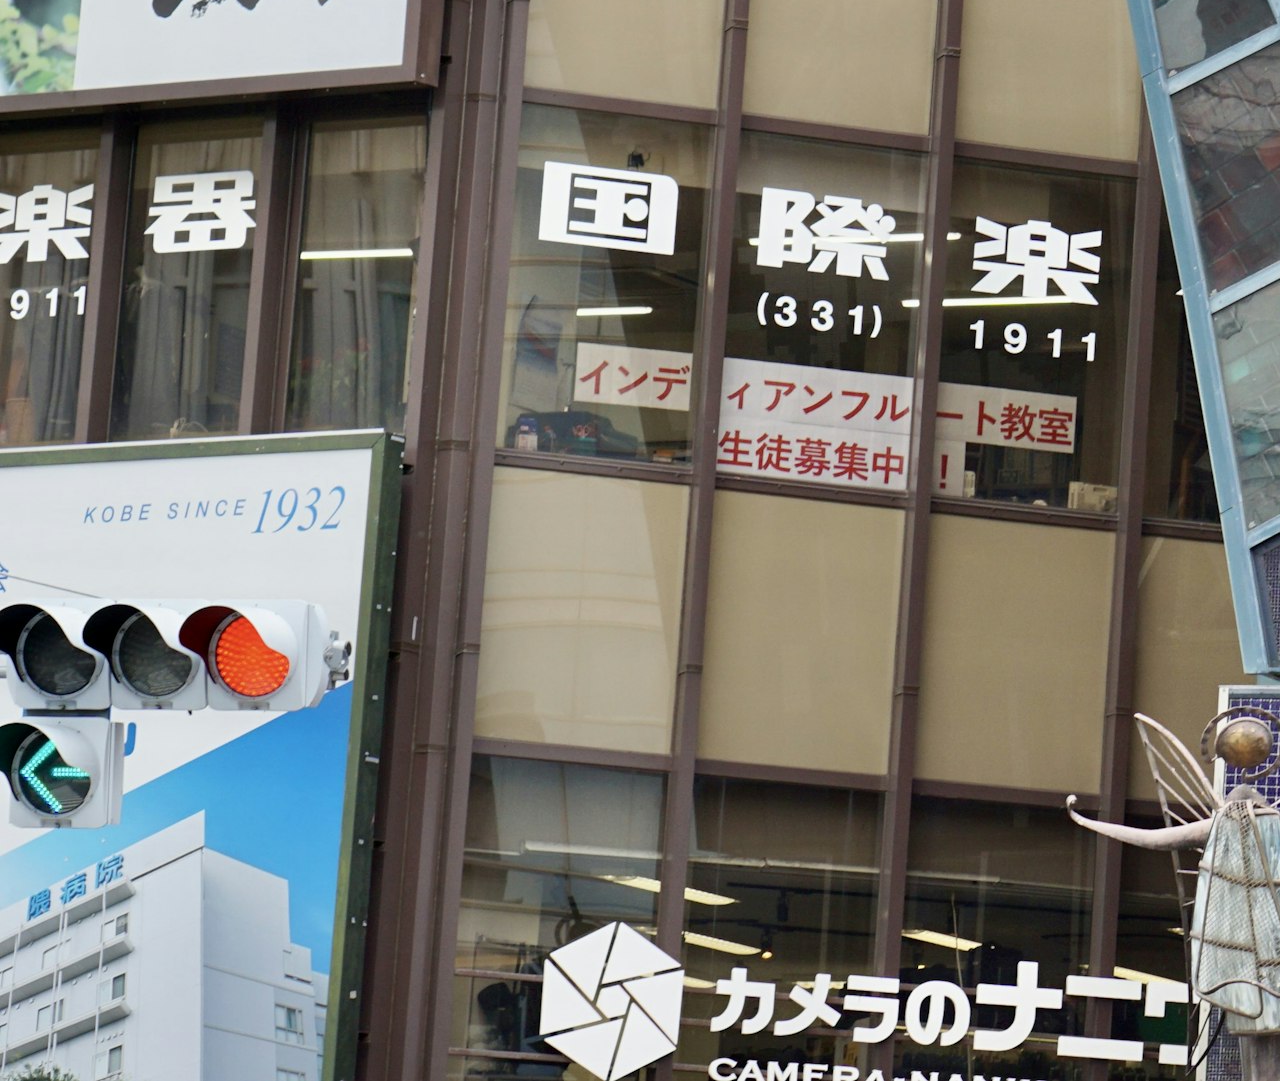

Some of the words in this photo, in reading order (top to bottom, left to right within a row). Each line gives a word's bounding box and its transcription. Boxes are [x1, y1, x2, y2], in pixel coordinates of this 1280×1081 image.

[757, 291, 882, 339] (331)
[969, 320, 1097, 362] 1911
[83, 504, 152, 524] KOBE
[167, 499, 247, 520] SINCE
[250, 486, 346, 534] 1932
